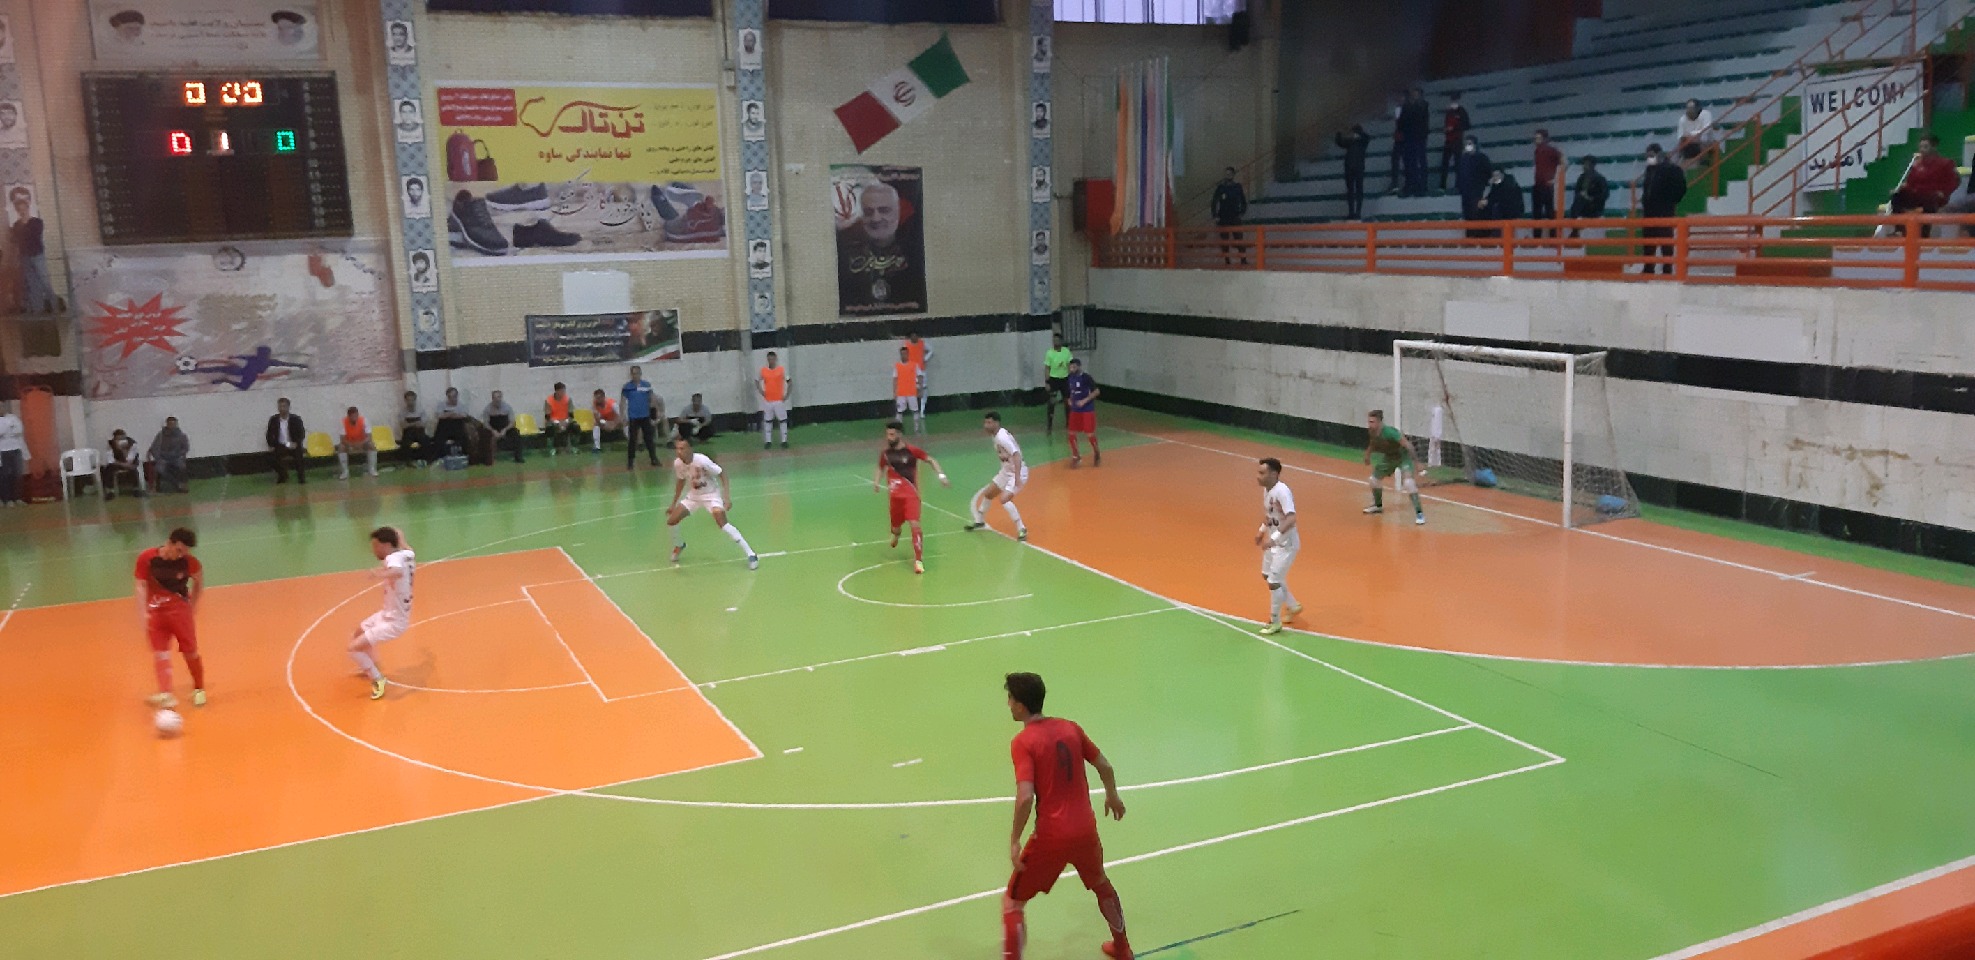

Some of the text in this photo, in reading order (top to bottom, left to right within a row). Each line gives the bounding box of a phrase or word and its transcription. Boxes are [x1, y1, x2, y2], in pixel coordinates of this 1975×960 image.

[610, 111, 646, 139] تن
[276, 130, 296, 151] 0
[538, 147, 563, 163] ساوه
[1056, 739, 1074, 782] 9
